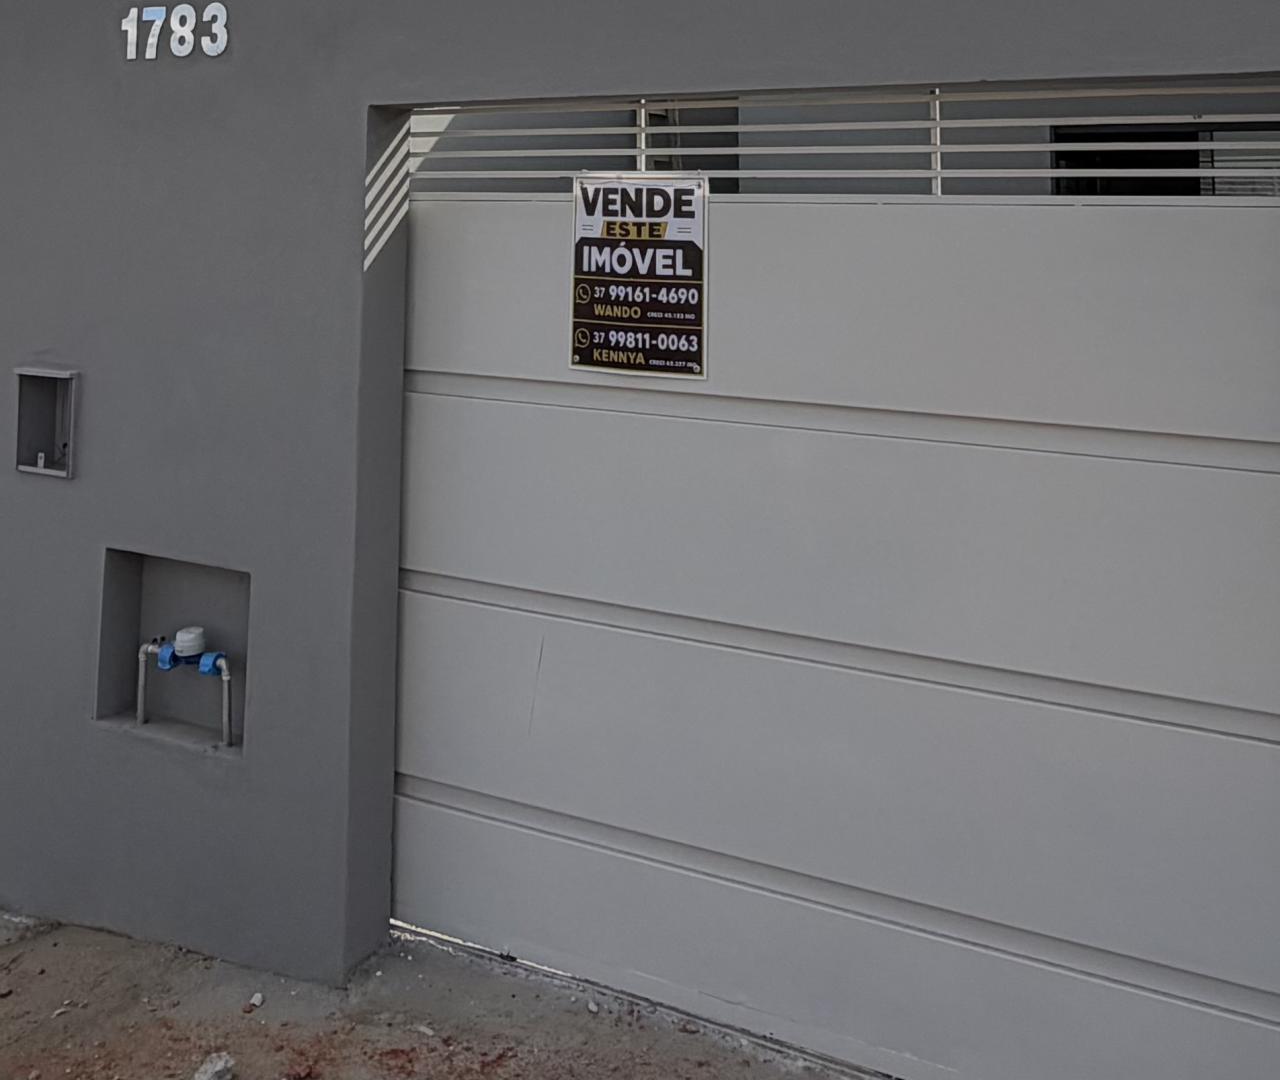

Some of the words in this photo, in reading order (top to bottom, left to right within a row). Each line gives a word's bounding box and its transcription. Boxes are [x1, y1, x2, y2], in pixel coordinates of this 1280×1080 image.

[121, 2, 228, 60] 1783
[581, 187, 696, 219] VENDE
[605, 221, 663, 238] ESTE
[582, 241, 693, 277] IMÓVEL
[594, 286, 605, 299] 37
[608, 285, 699, 305] 99161-4690
[594, 303, 641, 319] WANDO
[593, 331, 605, 344] 37
[608, 330, 699, 352] 99811-0063
[593, 348, 646, 365] KENNYA
